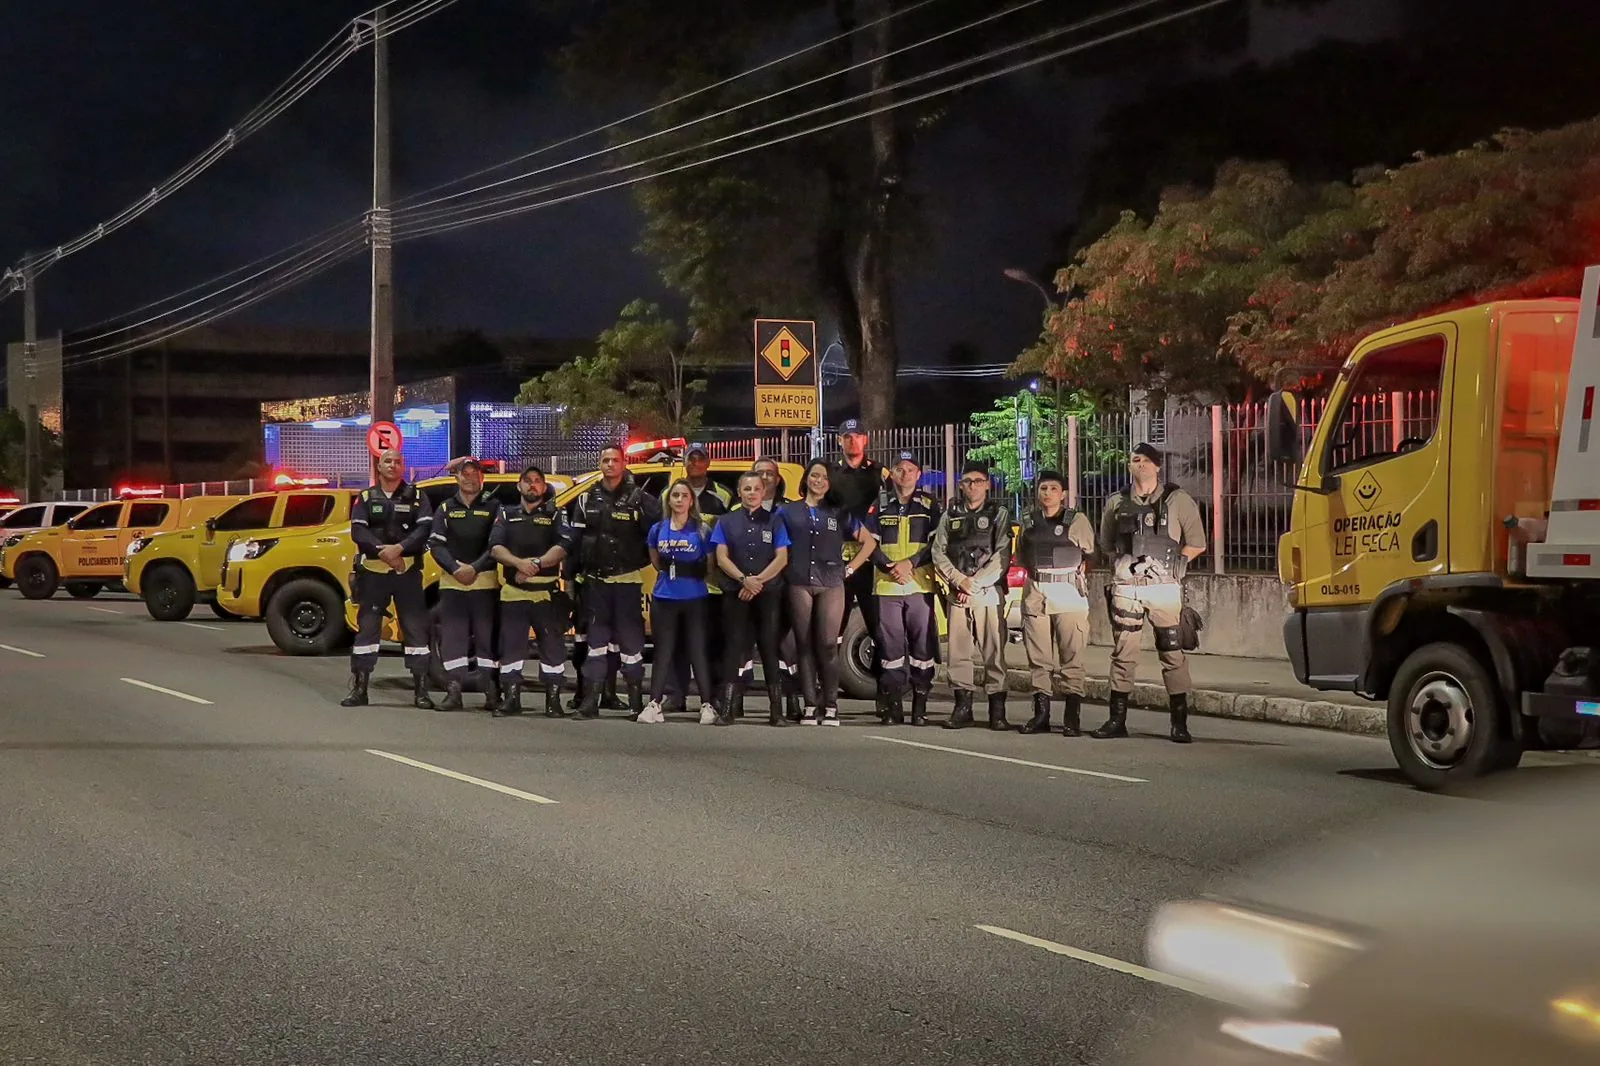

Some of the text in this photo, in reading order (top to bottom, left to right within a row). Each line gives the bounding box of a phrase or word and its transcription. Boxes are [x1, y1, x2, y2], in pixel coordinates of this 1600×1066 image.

[761, 393, 814, 405] SEMÁFORO
[774, 408, 812, 419] FRENTE
[1334, 512, 1401, 532] OPERAÇÃO
[1335, 532, 1399, 555] LEI SECA
[78, 556, 118, 567] POLICIAMENTO
[1321, 584, 1360, 595] OLS-015
